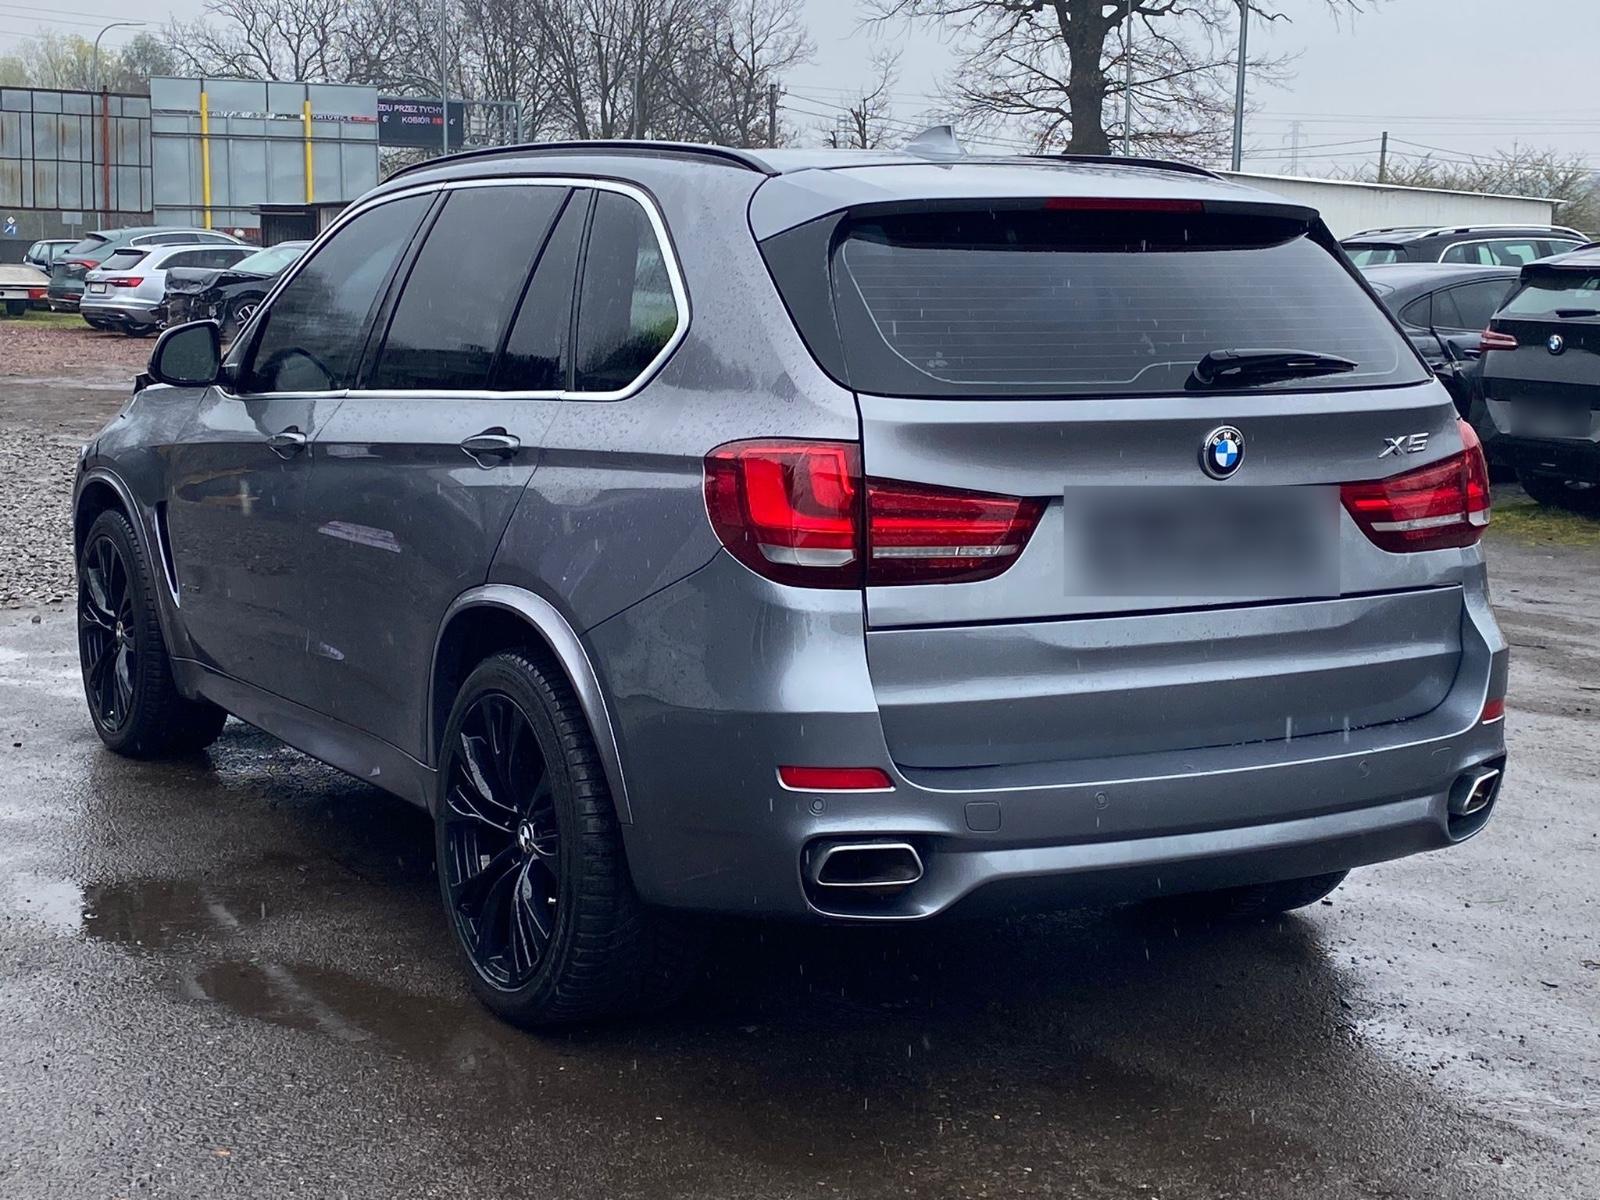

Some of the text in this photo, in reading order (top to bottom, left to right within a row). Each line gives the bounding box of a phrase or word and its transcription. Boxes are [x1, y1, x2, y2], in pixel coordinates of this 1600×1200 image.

[394, 104, 418, 113] PRZEZ
[419, 105, 444, 114] TYCHY
[1212, 431, 1242, 446] BMW
[1378, 432, 1430, 458] X5
